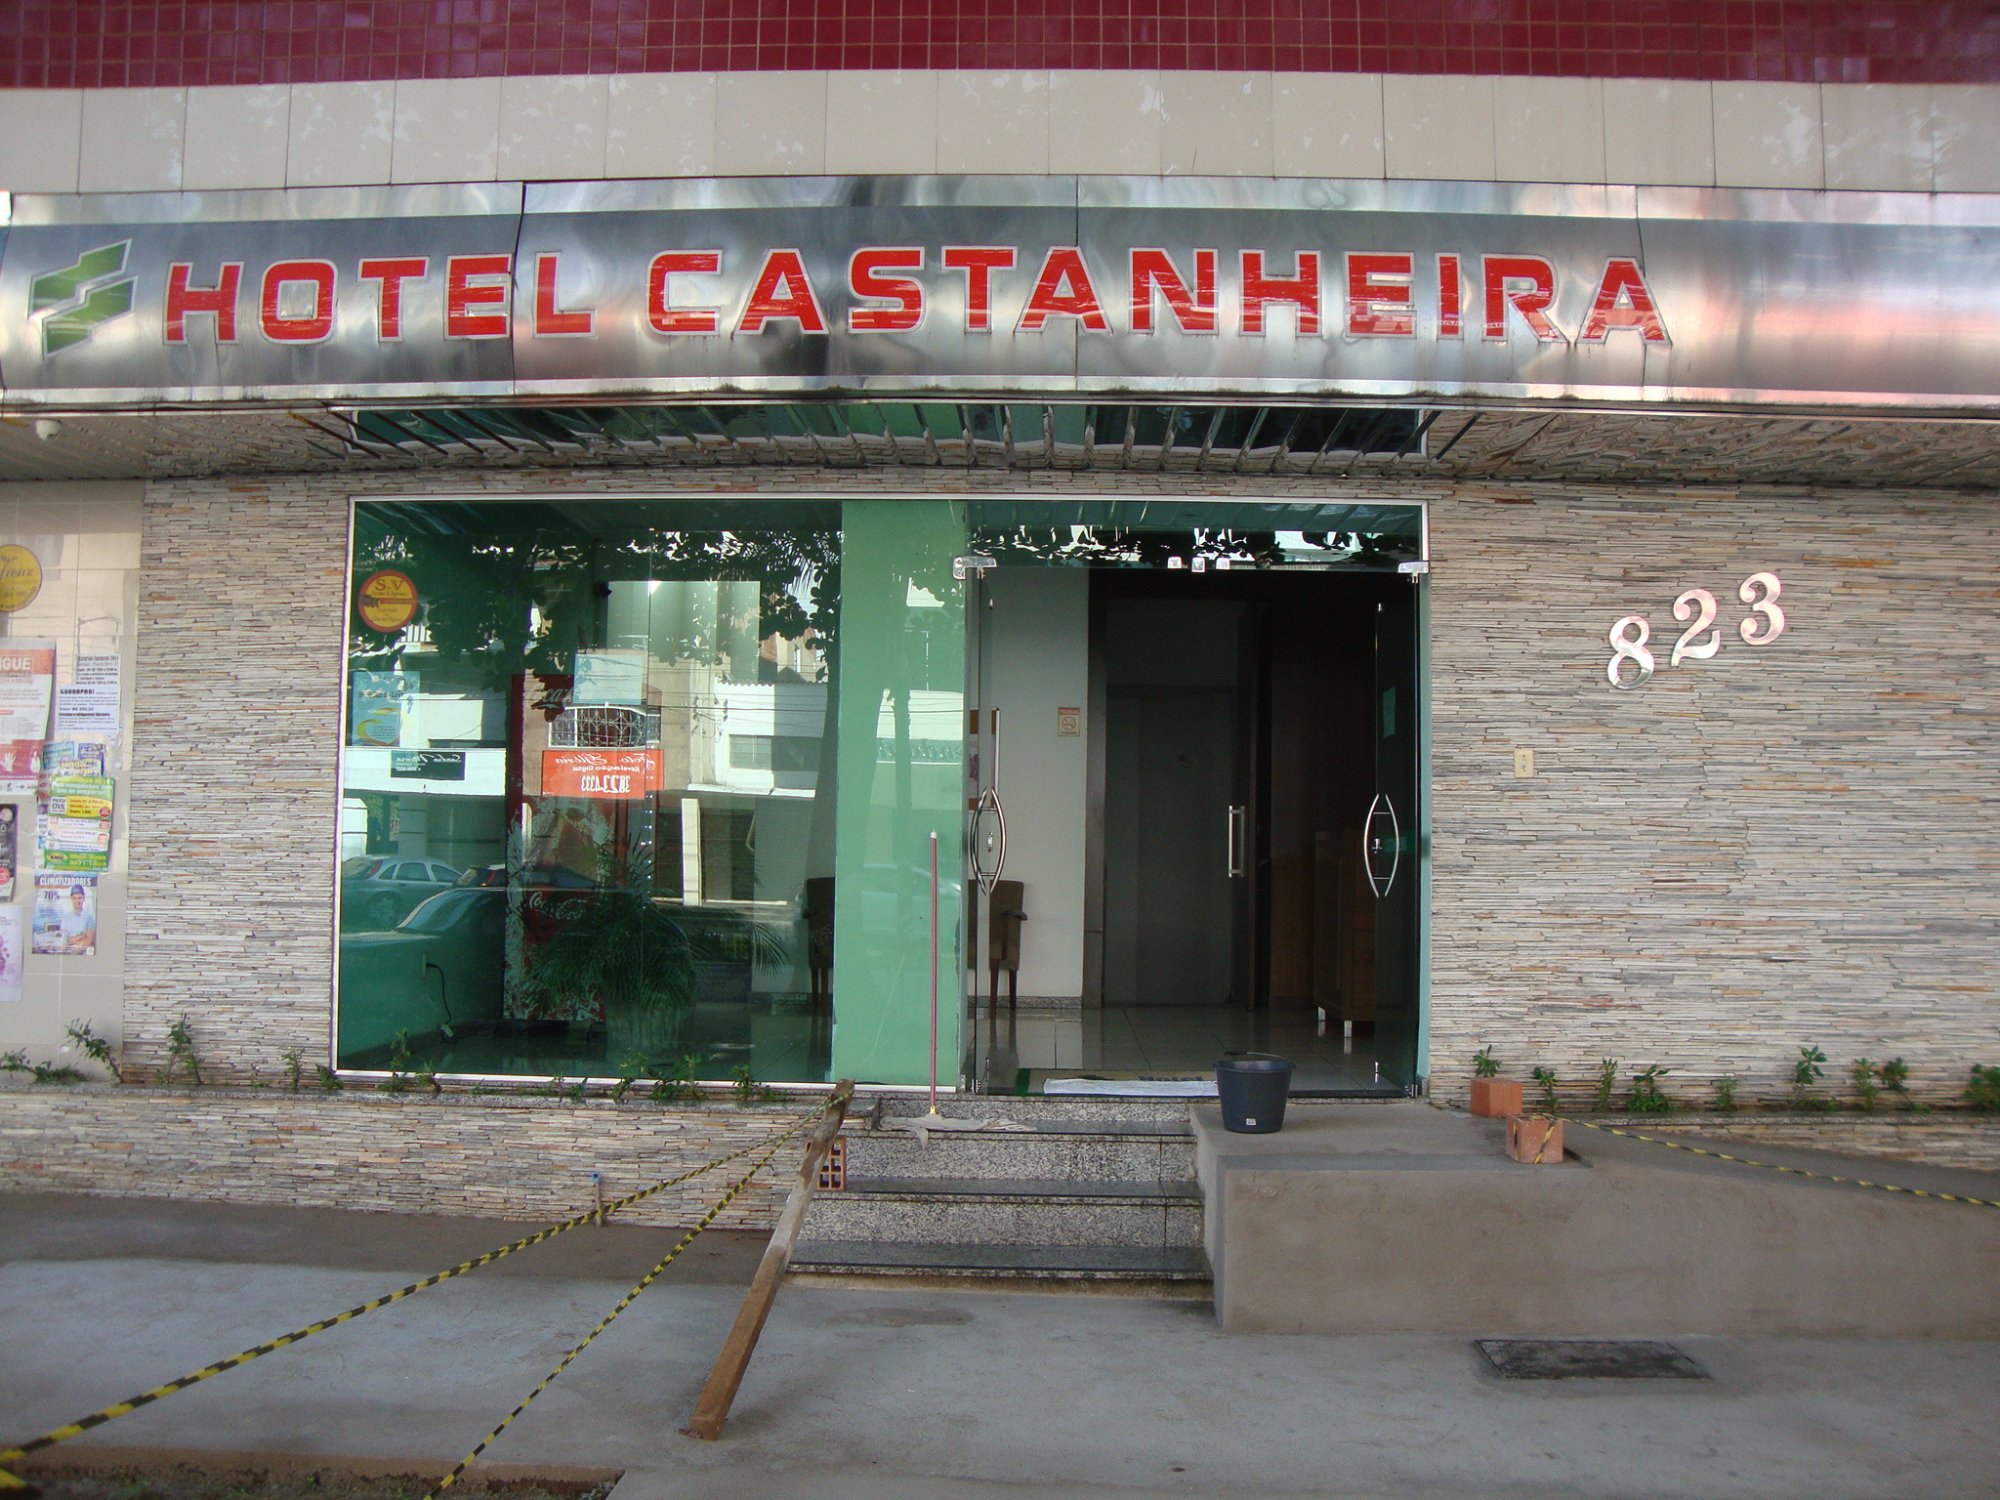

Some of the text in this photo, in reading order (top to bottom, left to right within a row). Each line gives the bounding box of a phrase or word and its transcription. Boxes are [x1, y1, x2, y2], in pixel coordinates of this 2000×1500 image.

[163, 246, 1672, 347] HOTEL CASTANHEIRA
[1607, 572, 1785, 690] 823
[40, 877, 92, 886] CLIMATIZADORES
